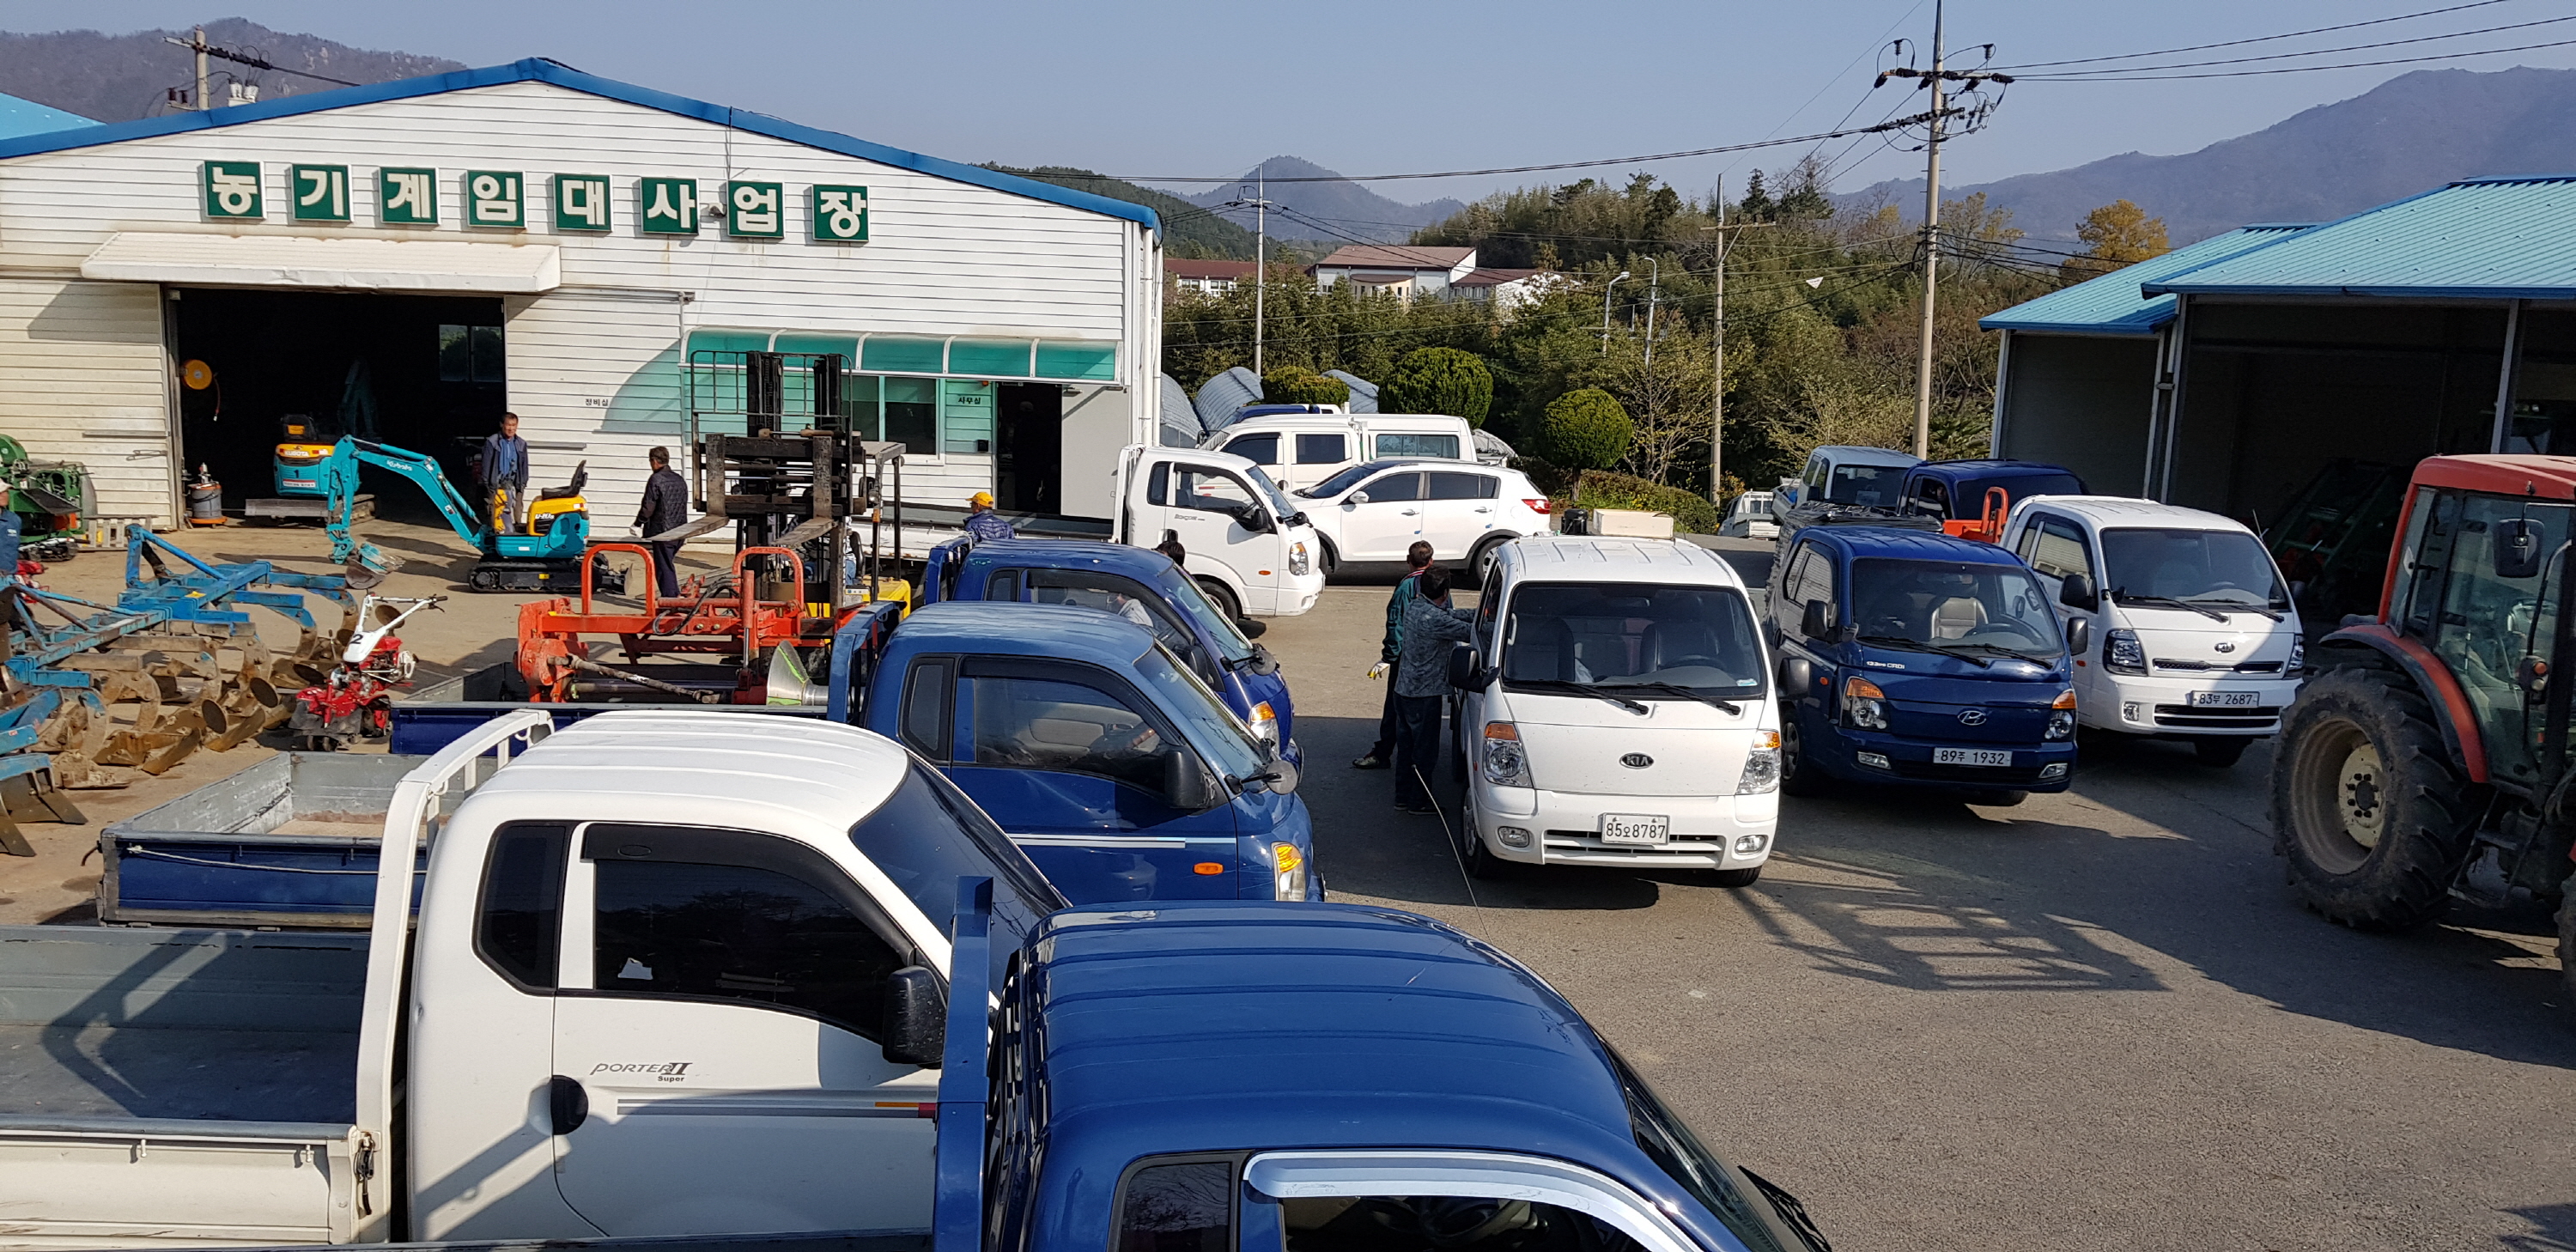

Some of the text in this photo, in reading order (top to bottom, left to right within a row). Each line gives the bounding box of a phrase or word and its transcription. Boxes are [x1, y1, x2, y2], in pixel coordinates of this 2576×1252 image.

[211, 167, 867, 238] 농기계임대사업장
[585, 398, 609, 407] 정비실
[957, 396, 981, 405] 사무실
[349, 634, 363, 644] 2
[2199, 693, 2253, 705] 83무 2687
[1626, 756, 1649, 766] KIA
[1941, 750, 2005, 764] 89주 1932
